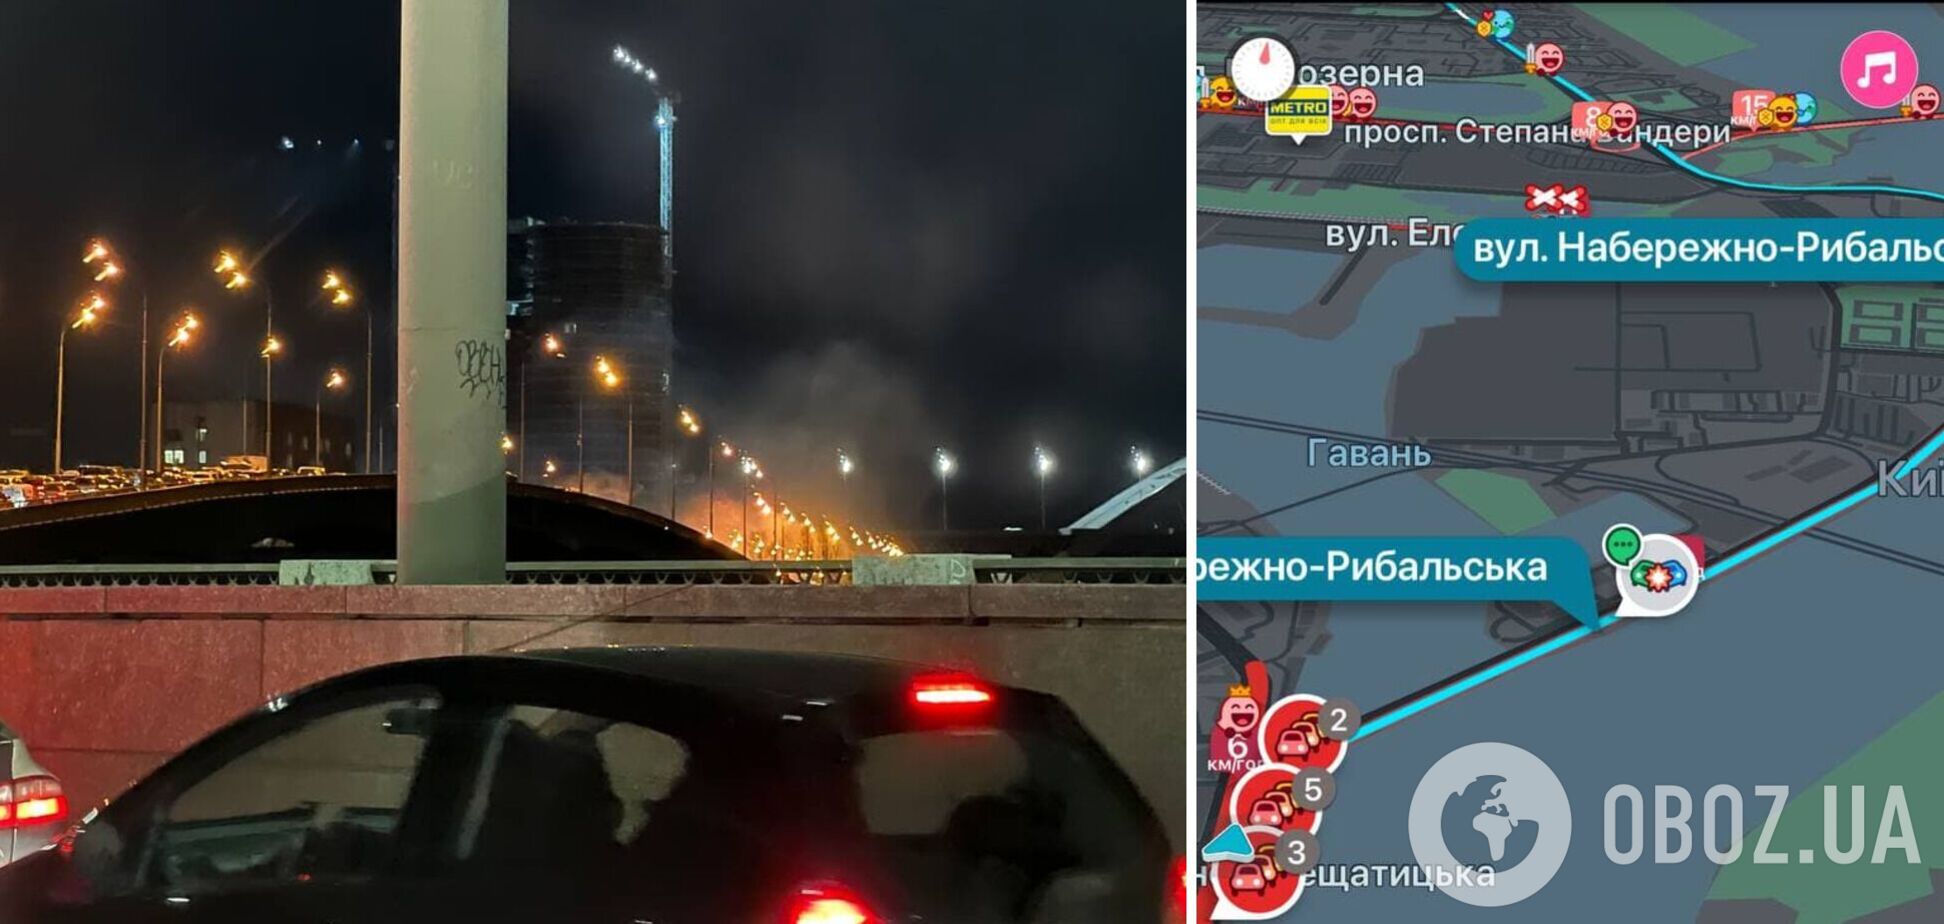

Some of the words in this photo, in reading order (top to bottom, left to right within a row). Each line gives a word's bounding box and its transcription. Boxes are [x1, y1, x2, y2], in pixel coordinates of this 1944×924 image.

[1270, 101, 1327, 113] METRO
[1585, 106, 1601, 128] 8
[1345, 123, 1447, 149] просп.
[1326, 223, 1398, 252] вул.
[1474, 238, 1548, 269] вул.
[1307, 437, 1431, 467] Гавань
[1330, 709, 1348, 732] 2
[1228, 733, 1248, 759] 6
[1304, 779, 1322, 801] 5
[1288, 841, 1306, 864] 3
